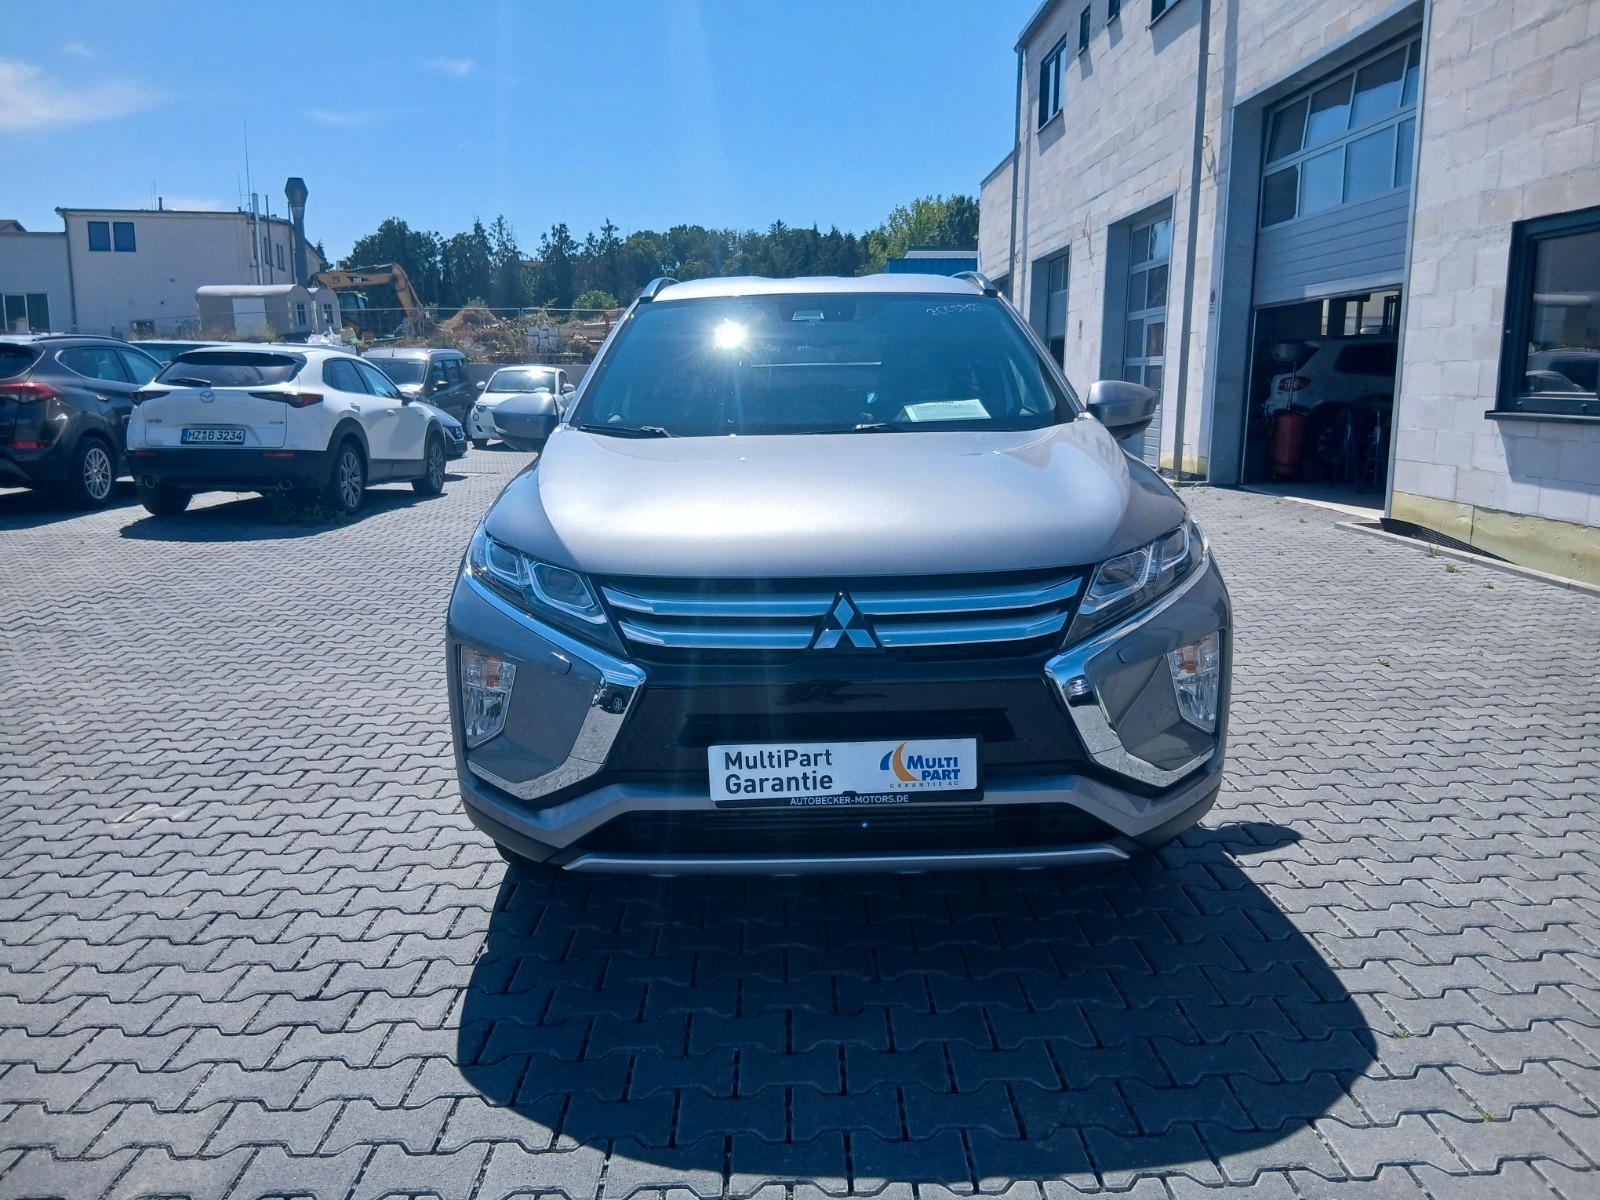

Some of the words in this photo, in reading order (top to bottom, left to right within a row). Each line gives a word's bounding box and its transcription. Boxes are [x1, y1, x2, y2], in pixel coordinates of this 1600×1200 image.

[188, 431, 201, 440] MZ
[207, 431, 215, 440] B
[217, 431, 242, 441] 3234
[724, 749, 833, 771] MultiPart
[907, 755, 959, 769] MULTI
[921, 769, 961, 781] PART
[725, 770, 833, 794] Garantie
[790, 795, 909, 806] AUTOBECKER-MOTORS.DE
